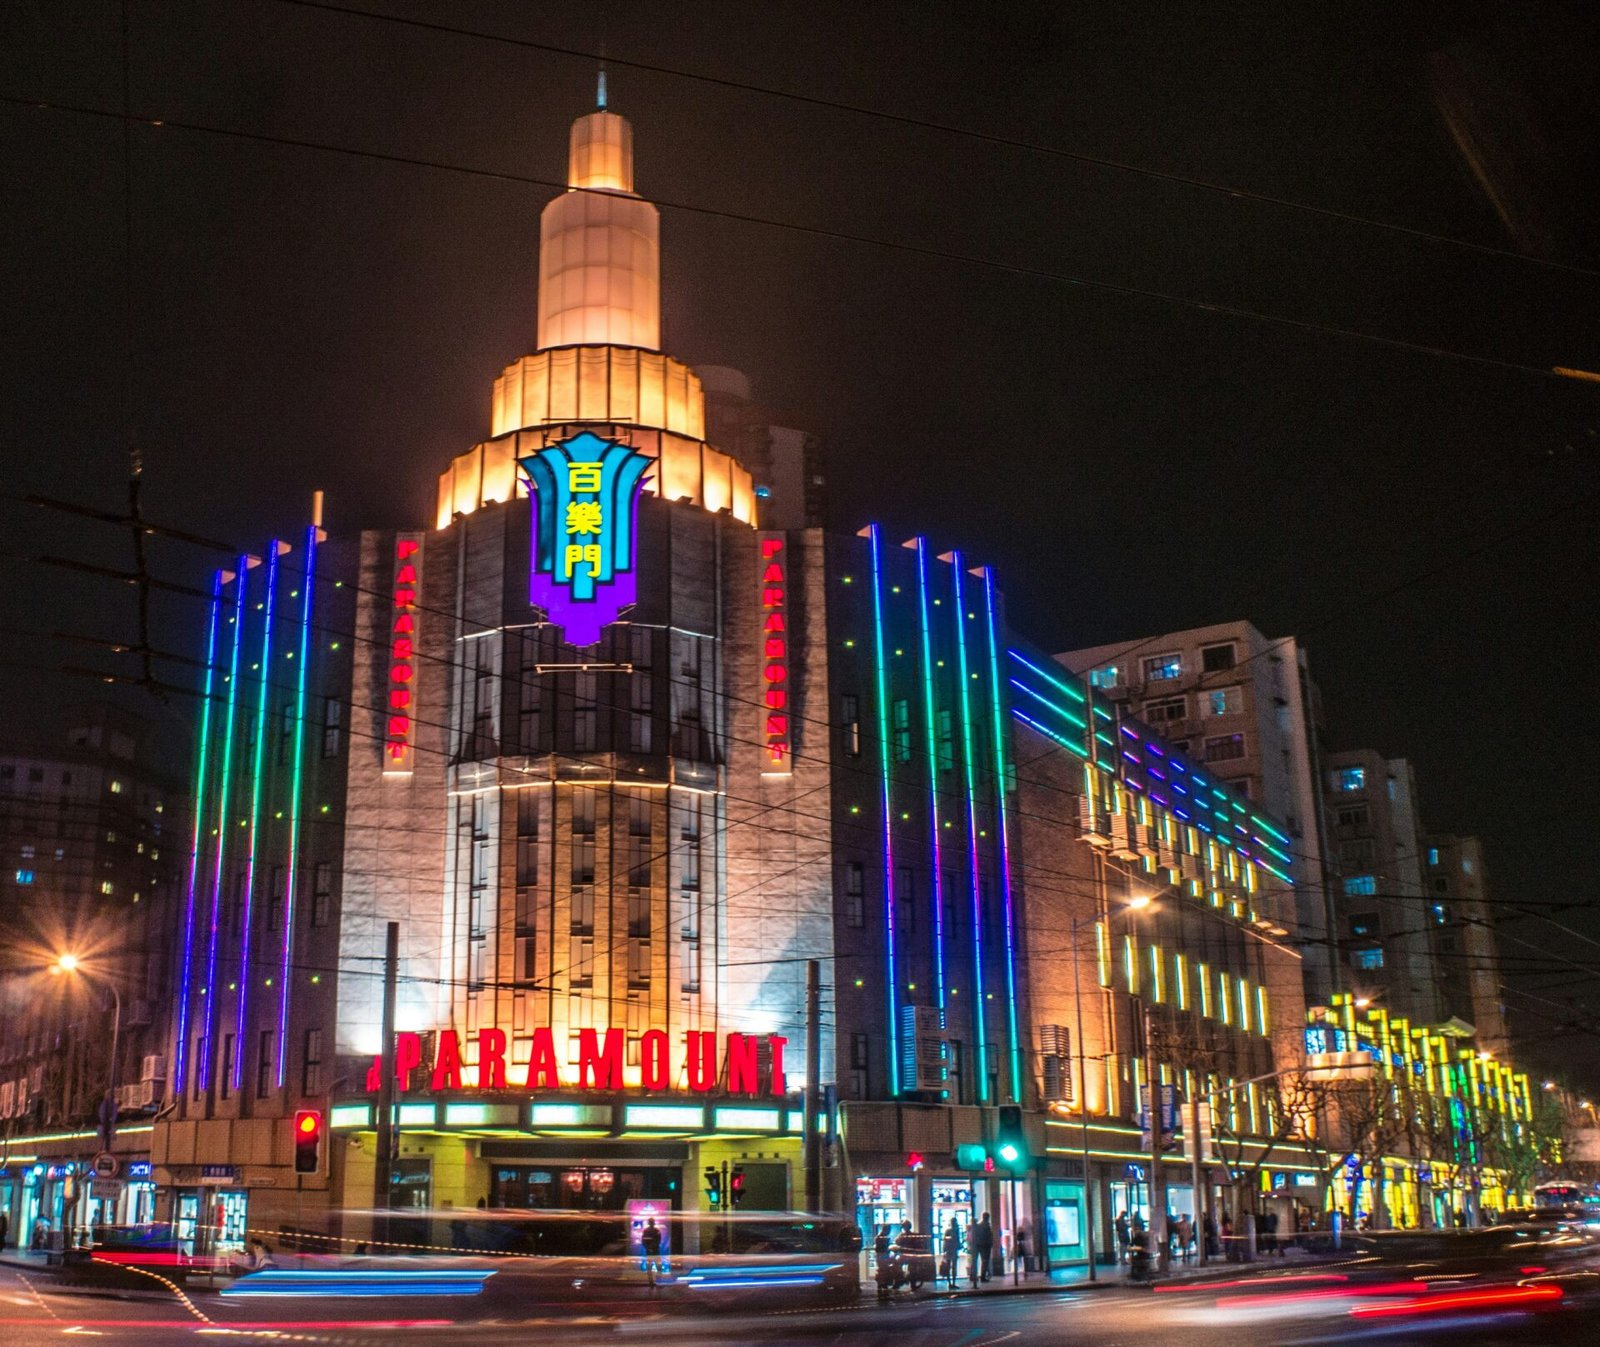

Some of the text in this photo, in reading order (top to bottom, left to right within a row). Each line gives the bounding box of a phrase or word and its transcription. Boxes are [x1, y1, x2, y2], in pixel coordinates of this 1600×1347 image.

[565, 462, 603, 578] 百樂門
[385, 540, 419, 762] PARAMOUNT
[761, 539, 789, 763] PARAMOUNT
[394, 1026, 790, 1096] PARAMOUNT
